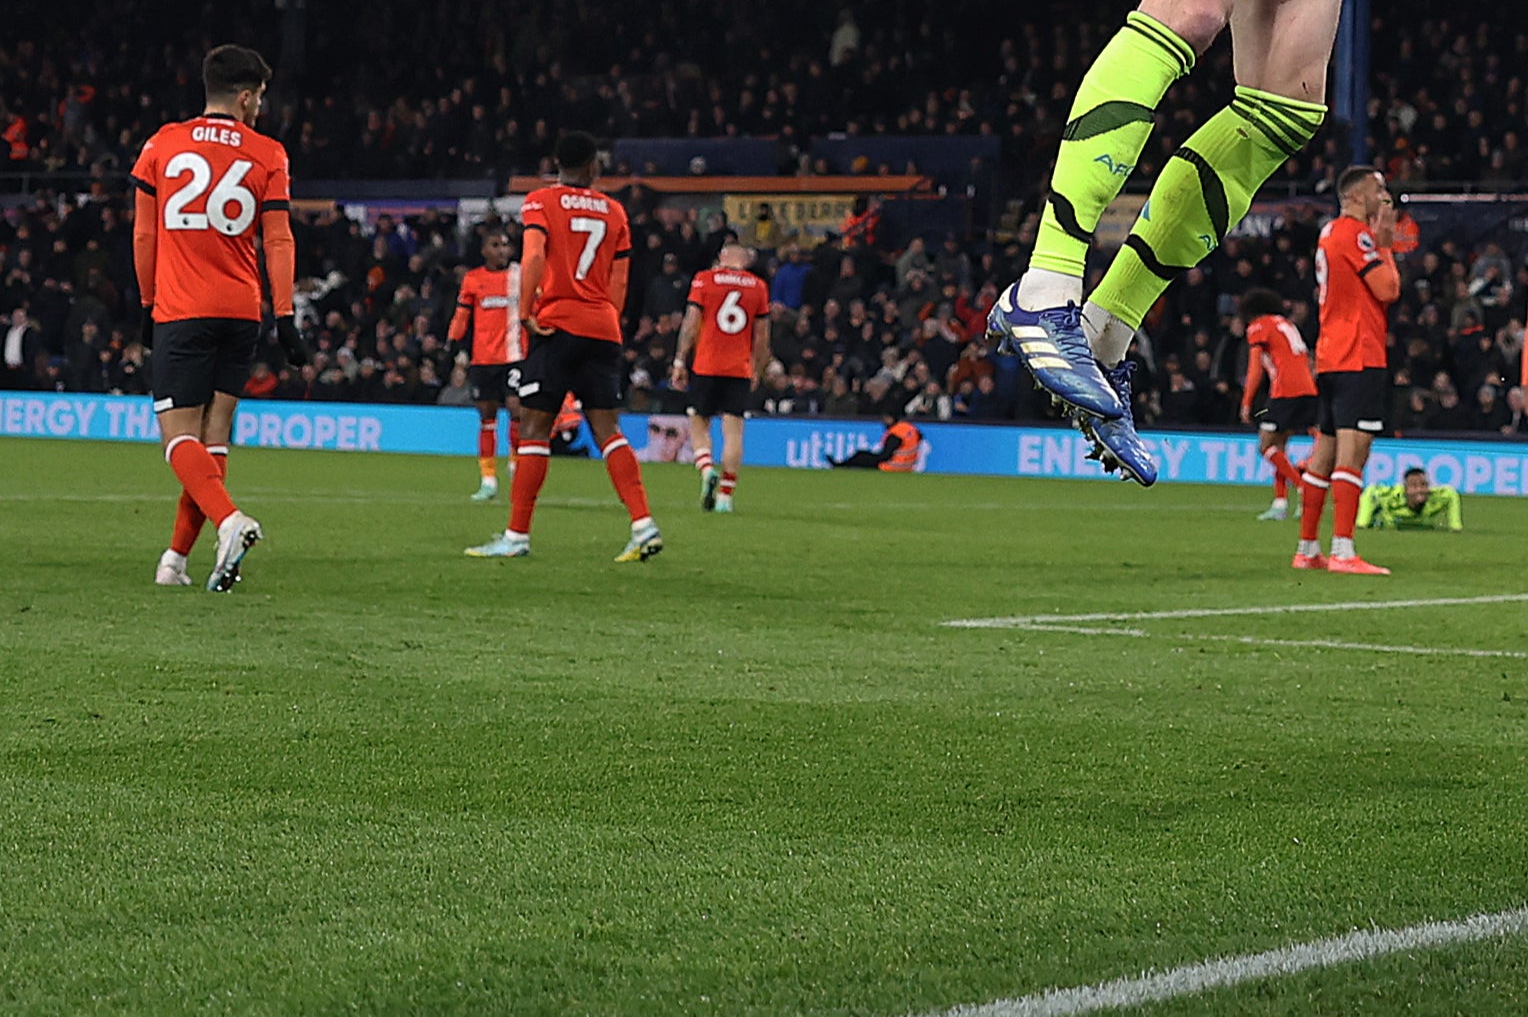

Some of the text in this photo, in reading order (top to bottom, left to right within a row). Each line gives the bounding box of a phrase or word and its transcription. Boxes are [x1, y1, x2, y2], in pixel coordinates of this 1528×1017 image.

[192, 127, 242, 147] GILES
[164, 152, 257, 236] 26
[570, 217, 607, 280] 7
[716, 290, 747, 335] 6
[236, 413, 382, 451] PROPER
